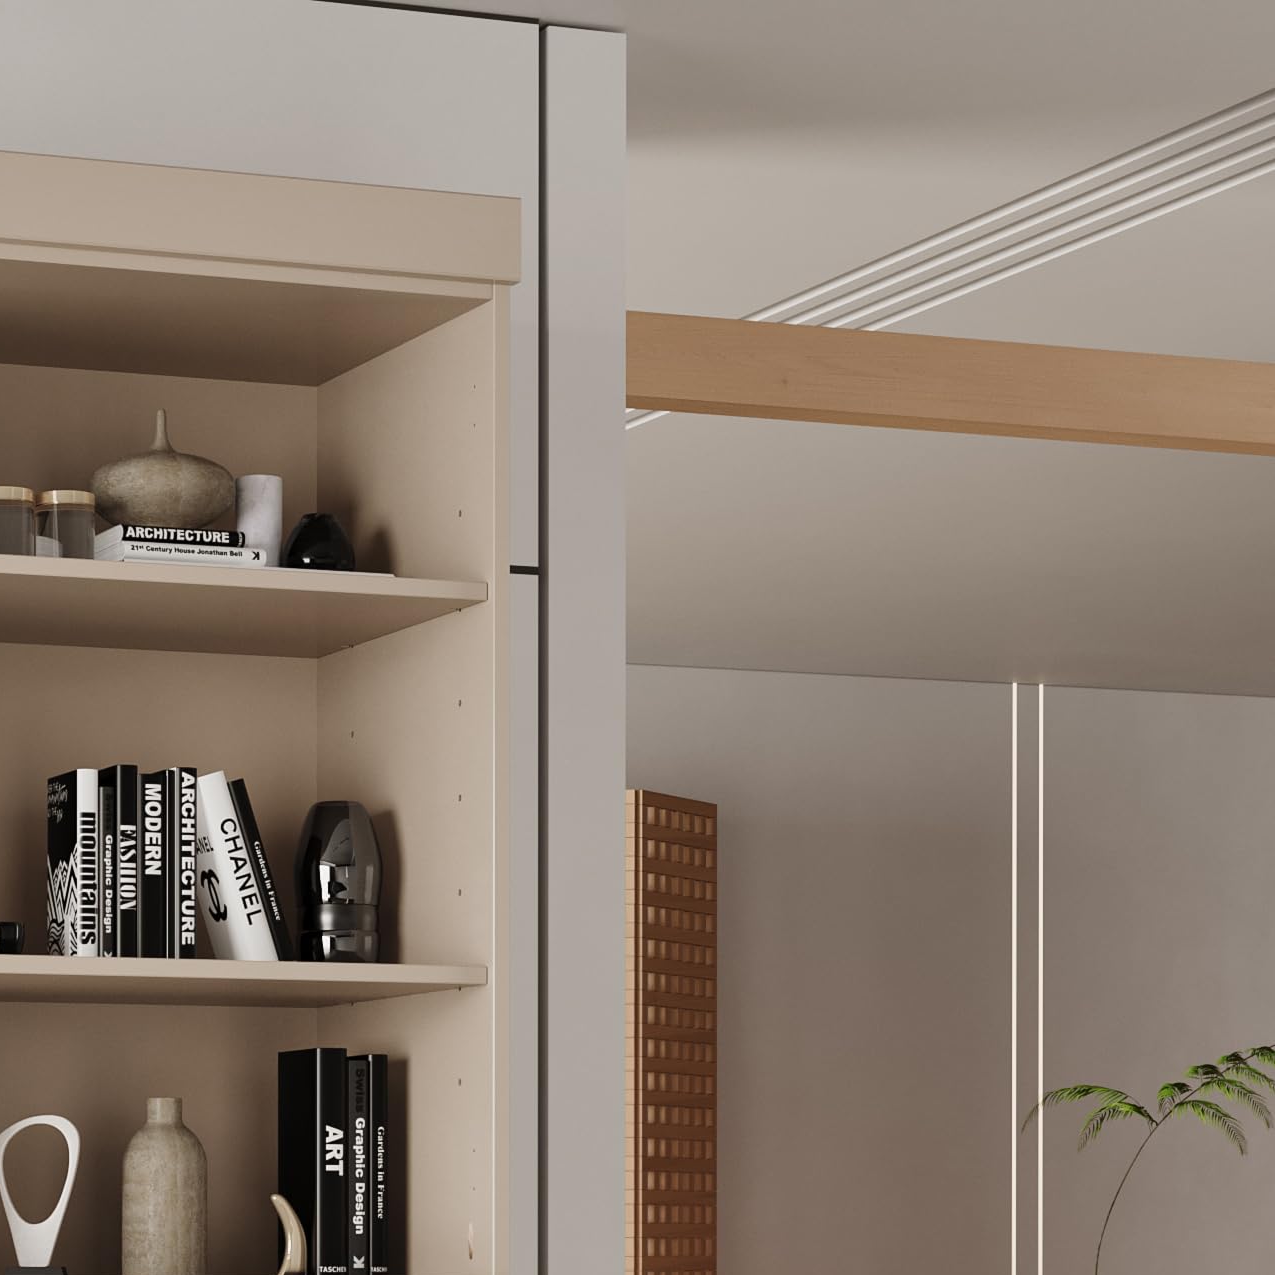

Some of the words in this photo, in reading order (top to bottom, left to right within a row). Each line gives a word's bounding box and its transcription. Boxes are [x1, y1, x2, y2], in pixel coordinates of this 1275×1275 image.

[126, 526, 229, 543] ARCHITECTURE
[144, 783, 161, 875] MODERN
[79, 812, 96, 945] mountains
[104, 834, 113, 886] Graphic
[121, 825, 136, 911] FASHION
[181, 771, 195, 945] ARCHITECTURE
[220, 818, 262, 925] CHANEL
[254, 841, 268, 879] Gardens
[268, 890, 281, 921] France
[104, 890, 113, 934] Design
[325, 1125, 344, 1176] ART
[353, 1117, 365, 1178] Graphic
[377, 1126, 385, 1168] Gardens
[353, 1182, 365, 1235] Design
[377, 1183, 385, 1219] France
